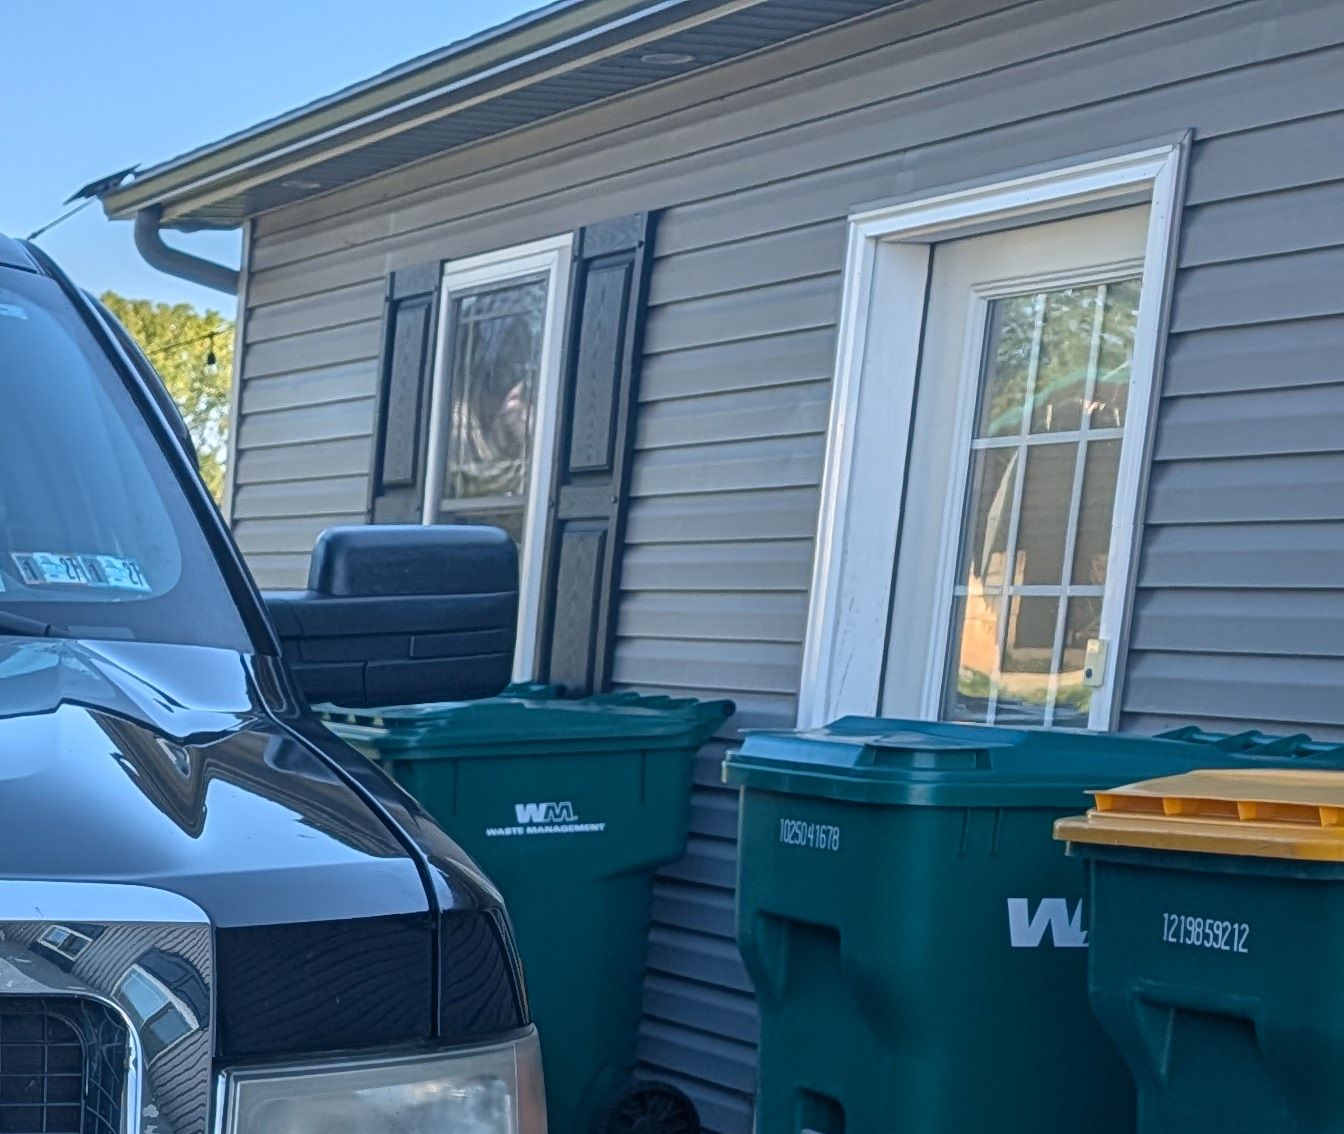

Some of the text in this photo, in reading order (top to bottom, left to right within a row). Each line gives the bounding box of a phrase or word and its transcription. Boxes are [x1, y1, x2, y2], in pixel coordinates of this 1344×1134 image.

[515, 801, 575, 823] WM
[486, 823, 606, 836] WASTE MANAGEMENT
[779, 818, 840, 851] 1025041678
[1163, 912, 1250, 953] 1219859212
